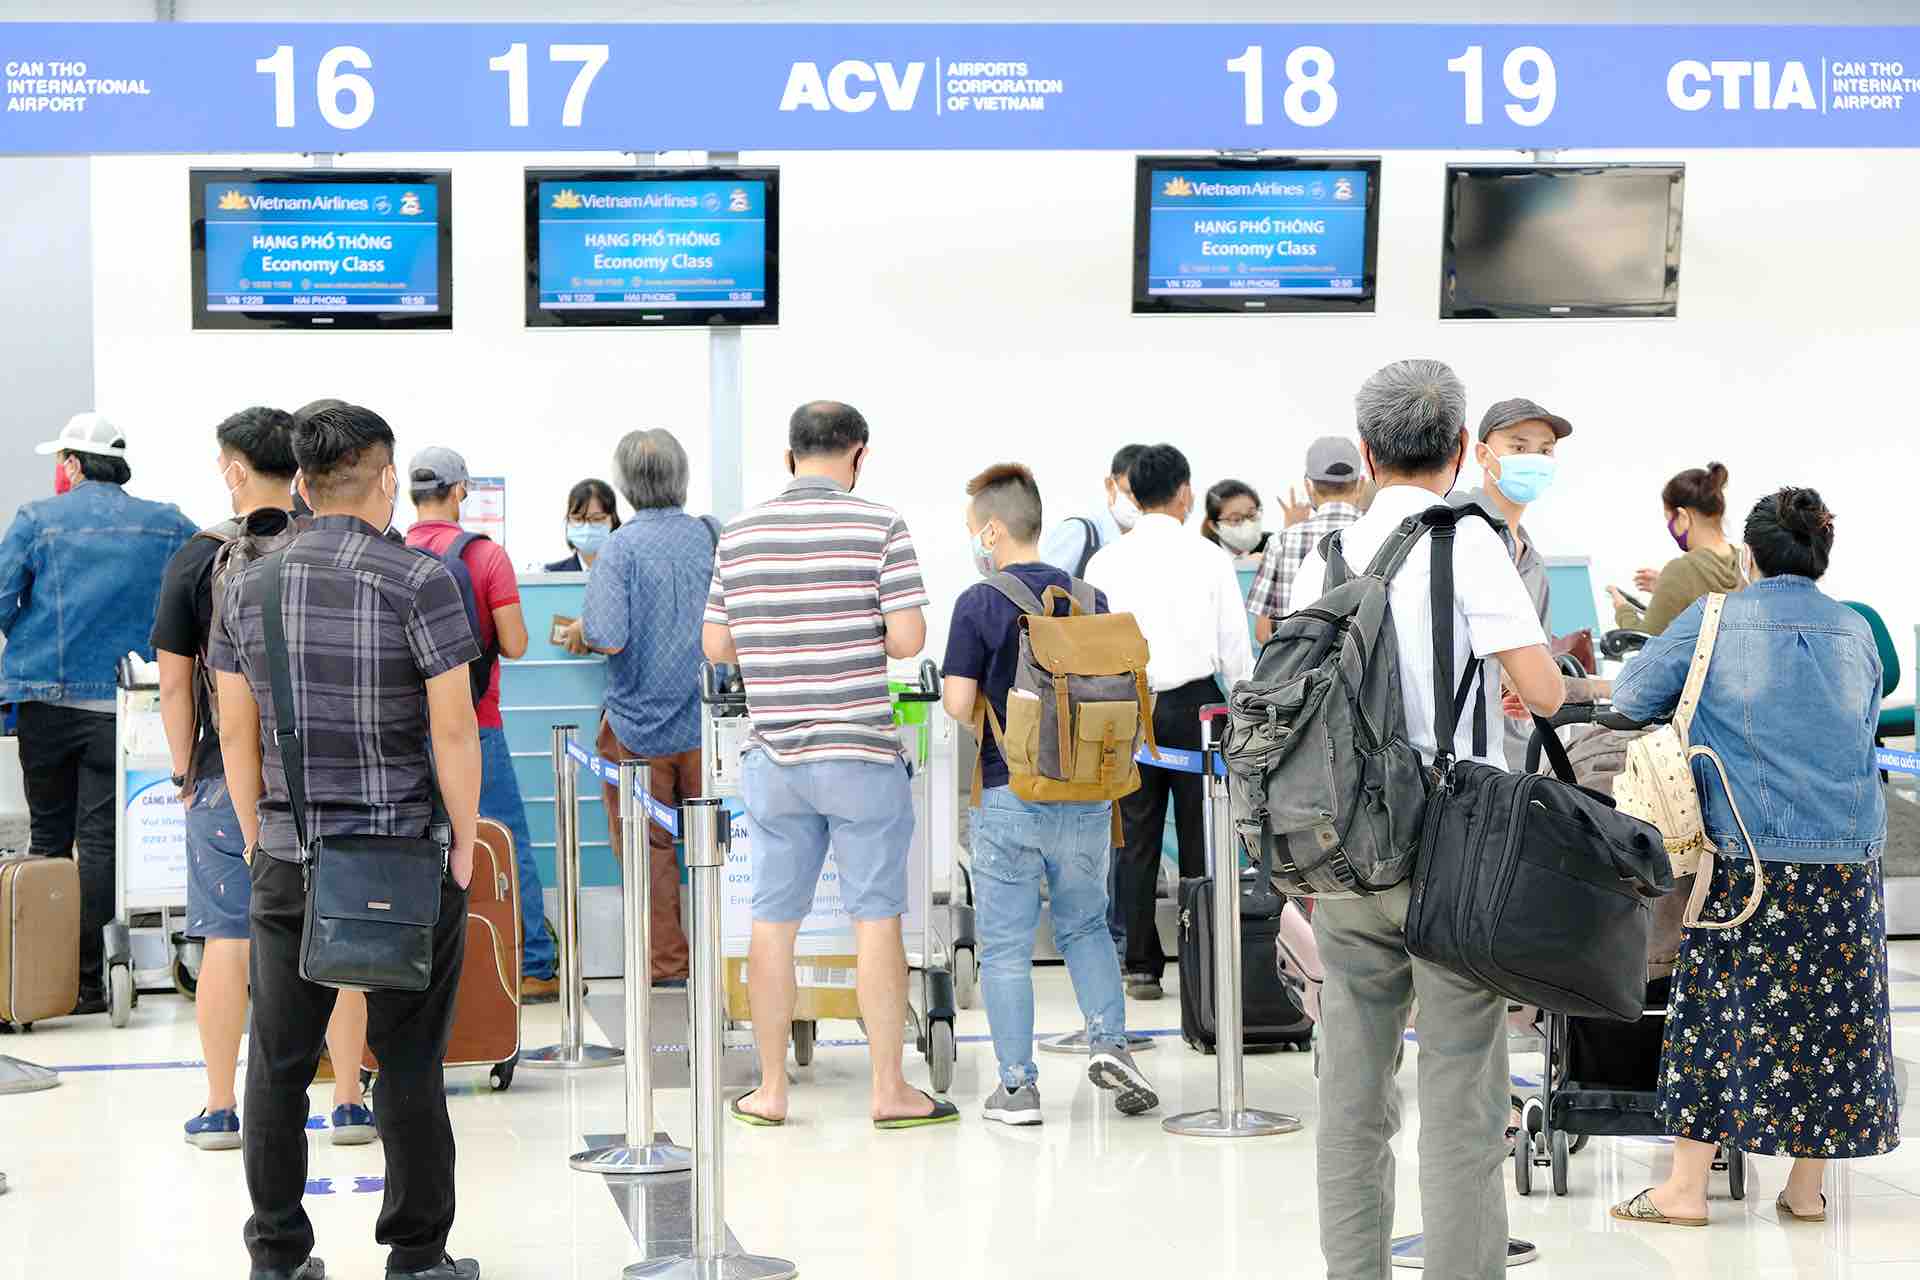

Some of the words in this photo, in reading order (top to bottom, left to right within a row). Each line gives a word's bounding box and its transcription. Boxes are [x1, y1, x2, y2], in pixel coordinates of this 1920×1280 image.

[6, 62, 43, 77] CAN
[49, 62, 87, 77] THO
[947, 62, 1028, 77] AIRPORTS
[1832, 62, 1866, 77] CAN
[1871, 62, 1904, 77] THO
[7, 79, 150, 95] INTERNATIONAL
[256, 45, 375, 130] 16
[489, 43, 609, 127] 17
[779, 60, 925, 113] ACV
[947, 79, 1063, 94] CORPORATION
[1226, 45, 1338, 127] 18
[1447, 45, 1557, 127] 19
[1666, 60, 1817, 111] CTIA
[7, 97, 86, 112] AIRPORT
[947, 97, 968, 111] OF
[974, 97, 1044, 111] VIETNAM
[1832, 96, 1904, 109] AIRPORT
[1194, 219, 1237, 236] HẠNG
[1275, 218, 1325, 233] THÔNG
[253, 235, 298, 252] HẠNG
[336, 234, 392, 249] THÔNG
[585, 232, 629, 249] HẠNG
[669, 231, 720, 246] THÔNG
[1202, 240, 1273, 259] Economy
[1277, 240, 1317, 255] Class
[262, 257, 339, 275] Economy
[342, 257, 385, 272] Class
[594, 253, 669, 271] Economy
[672, 253, 713, 268] Class
